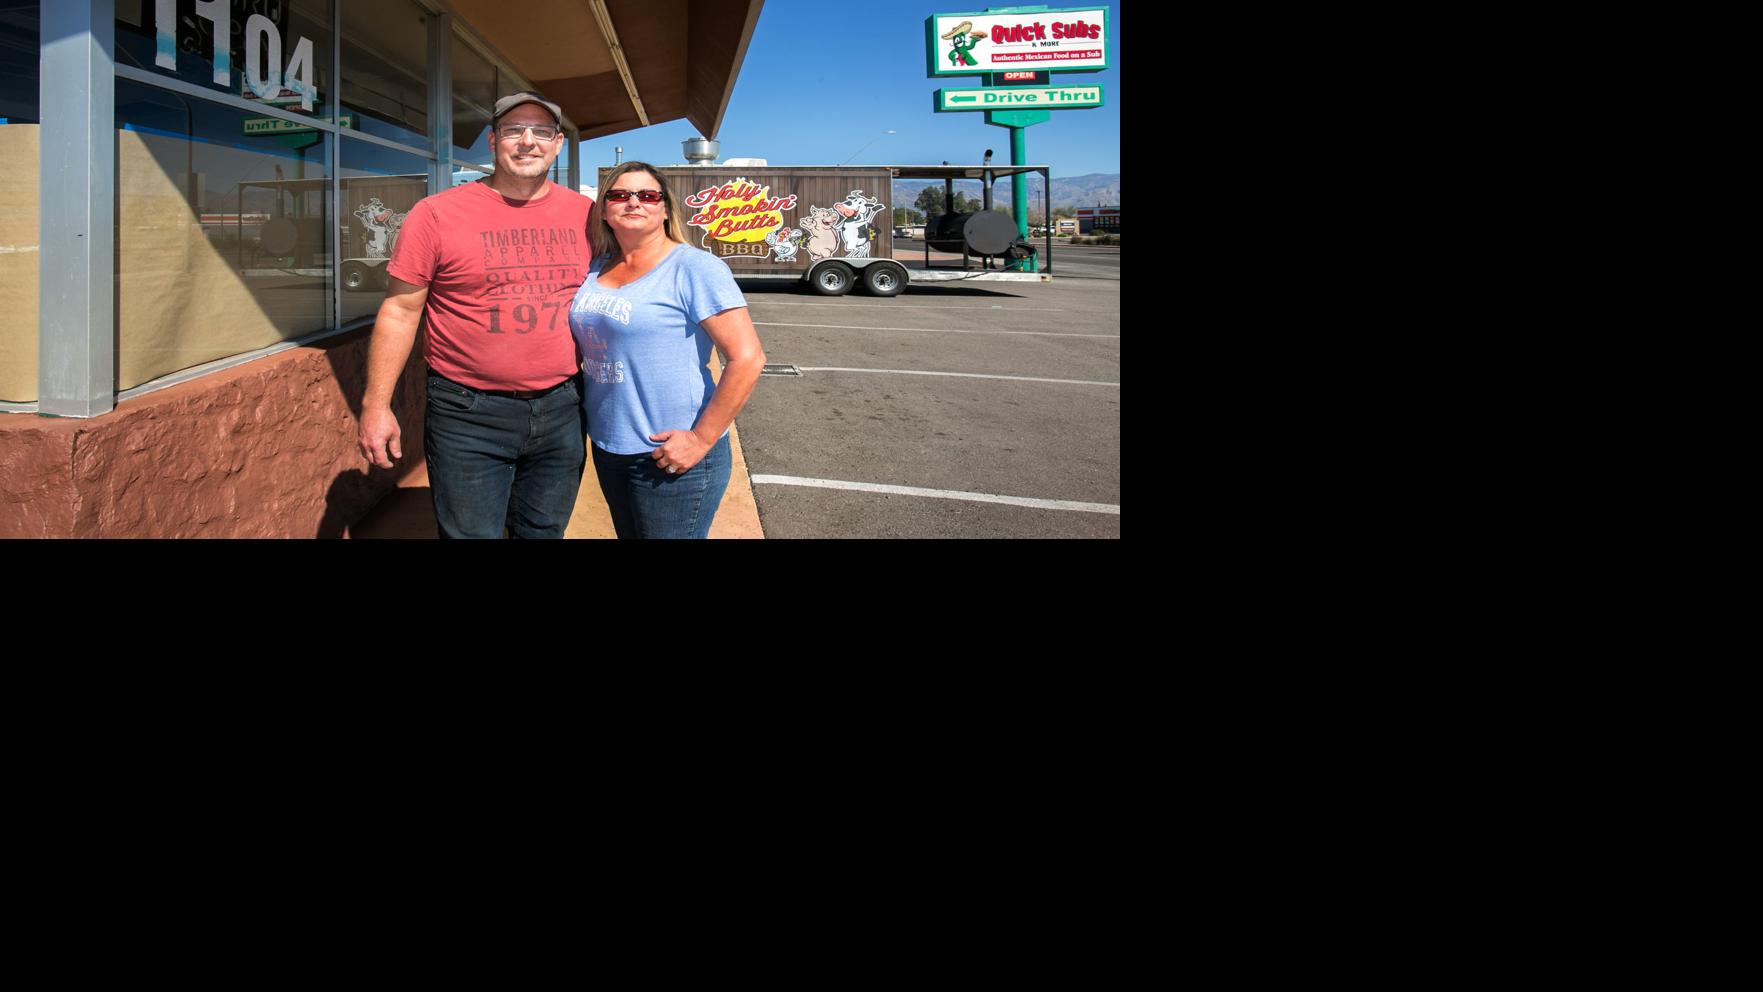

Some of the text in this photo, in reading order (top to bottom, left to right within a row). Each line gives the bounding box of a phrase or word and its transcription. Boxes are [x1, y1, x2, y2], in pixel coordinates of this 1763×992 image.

[1025, 53, 1052, 61] Mexican
[984, 90, 1095, 103] Drive Thru
[686, 182, 762, 207] Holy
[708, 214, 780, 238] Butts
[480, 228, 577, 248] TIMBERLAND
[484, 246, 580, 259] APPAREL
[721, 243, 763, 256] BBQ
[486, 300, 569, 335] 197
